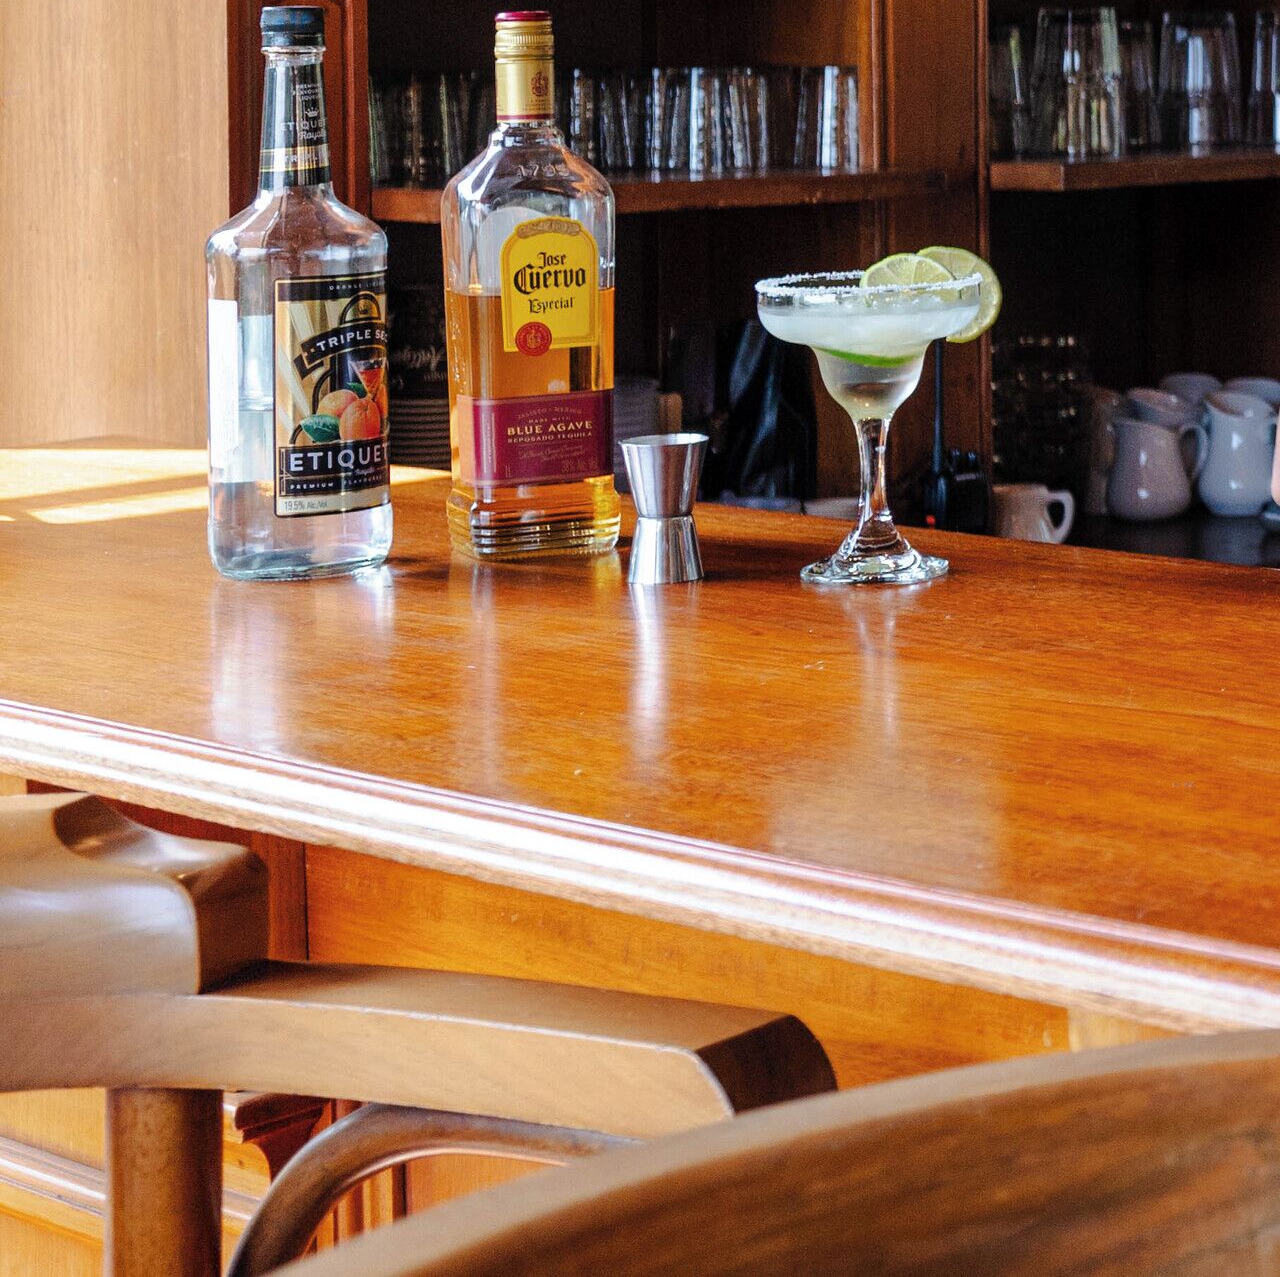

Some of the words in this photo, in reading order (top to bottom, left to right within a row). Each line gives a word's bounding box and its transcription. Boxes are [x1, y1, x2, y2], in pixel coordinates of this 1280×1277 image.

[537, 251, 567, 269] Jose
[513, 263, 586, 295] Cuervo
[528, 296, 575, 314] Especial
[316, 329, 371, 351] TRIPLE
[507, 425, 543, 436] BLUE
[548, 421, 593, 433] AGAVE
[507, 435, 554, 443] REPOSADO
[290, 482, 334, 490] PREMIUM
